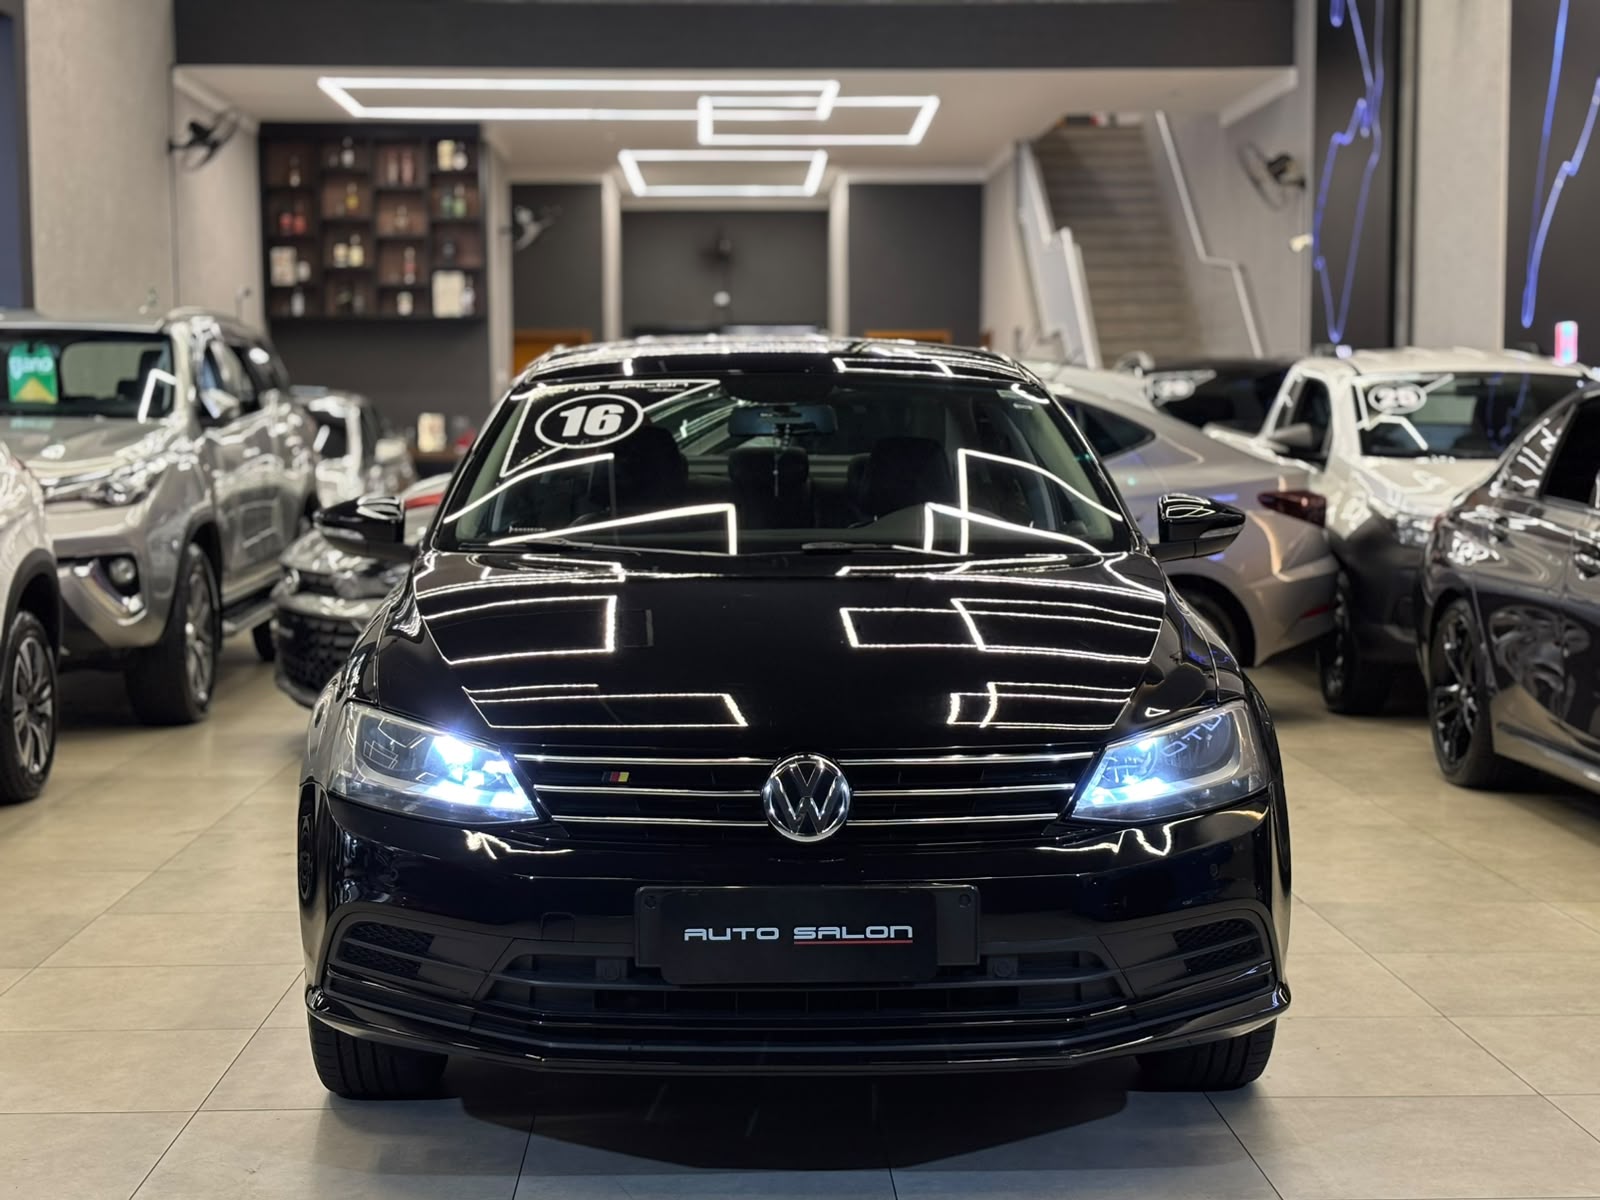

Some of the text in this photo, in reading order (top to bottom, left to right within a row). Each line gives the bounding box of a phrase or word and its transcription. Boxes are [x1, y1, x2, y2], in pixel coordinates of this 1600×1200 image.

[559, 404, 625, 437] 16
[765, 756, 848, 839] VW
[684, 925, 913, 941] AUTO SALON
